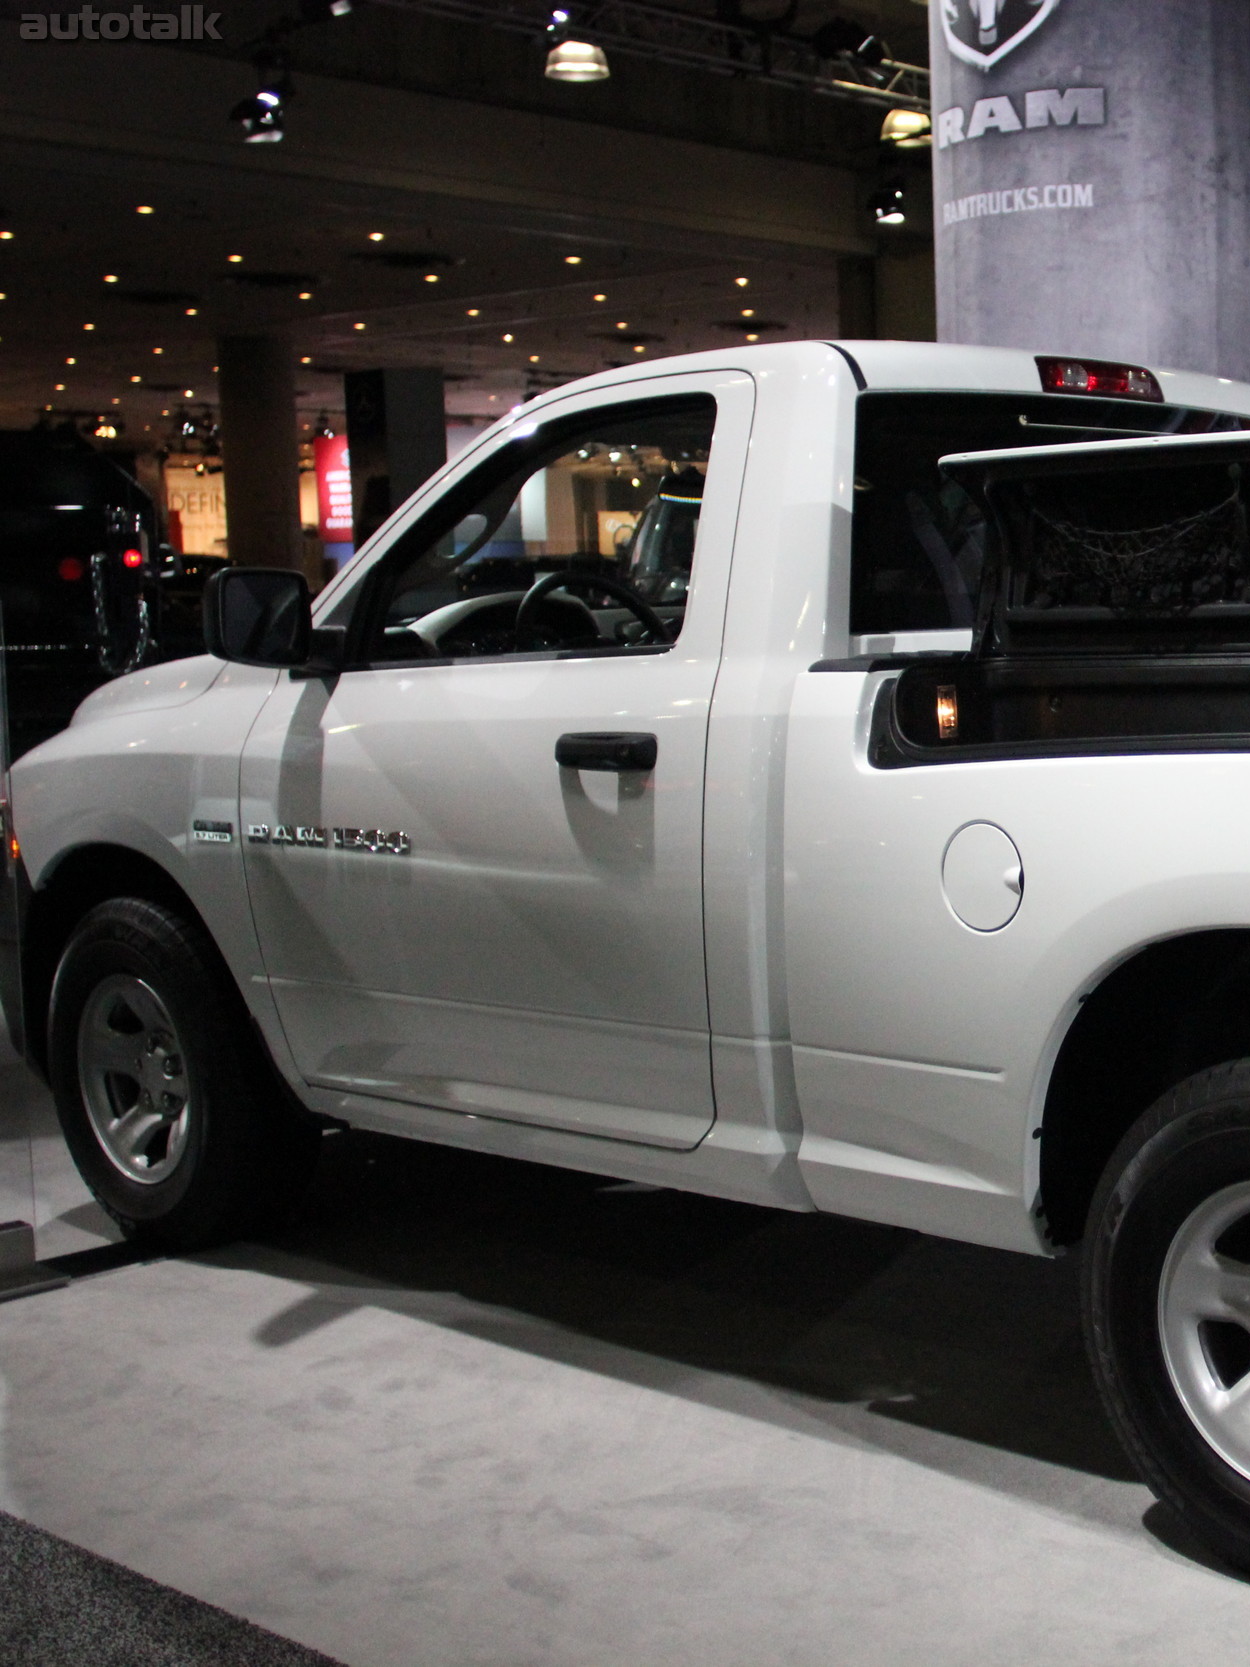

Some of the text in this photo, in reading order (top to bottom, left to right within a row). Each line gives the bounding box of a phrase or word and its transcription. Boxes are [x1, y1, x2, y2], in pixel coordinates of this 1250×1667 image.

[938, 87, 1105, 150] RAM
[943, 183, 1094, 225] RAMTRUCKS.COM
[248, 824, 328, 847] RAM
[333, 827, 411, 855] 1500
